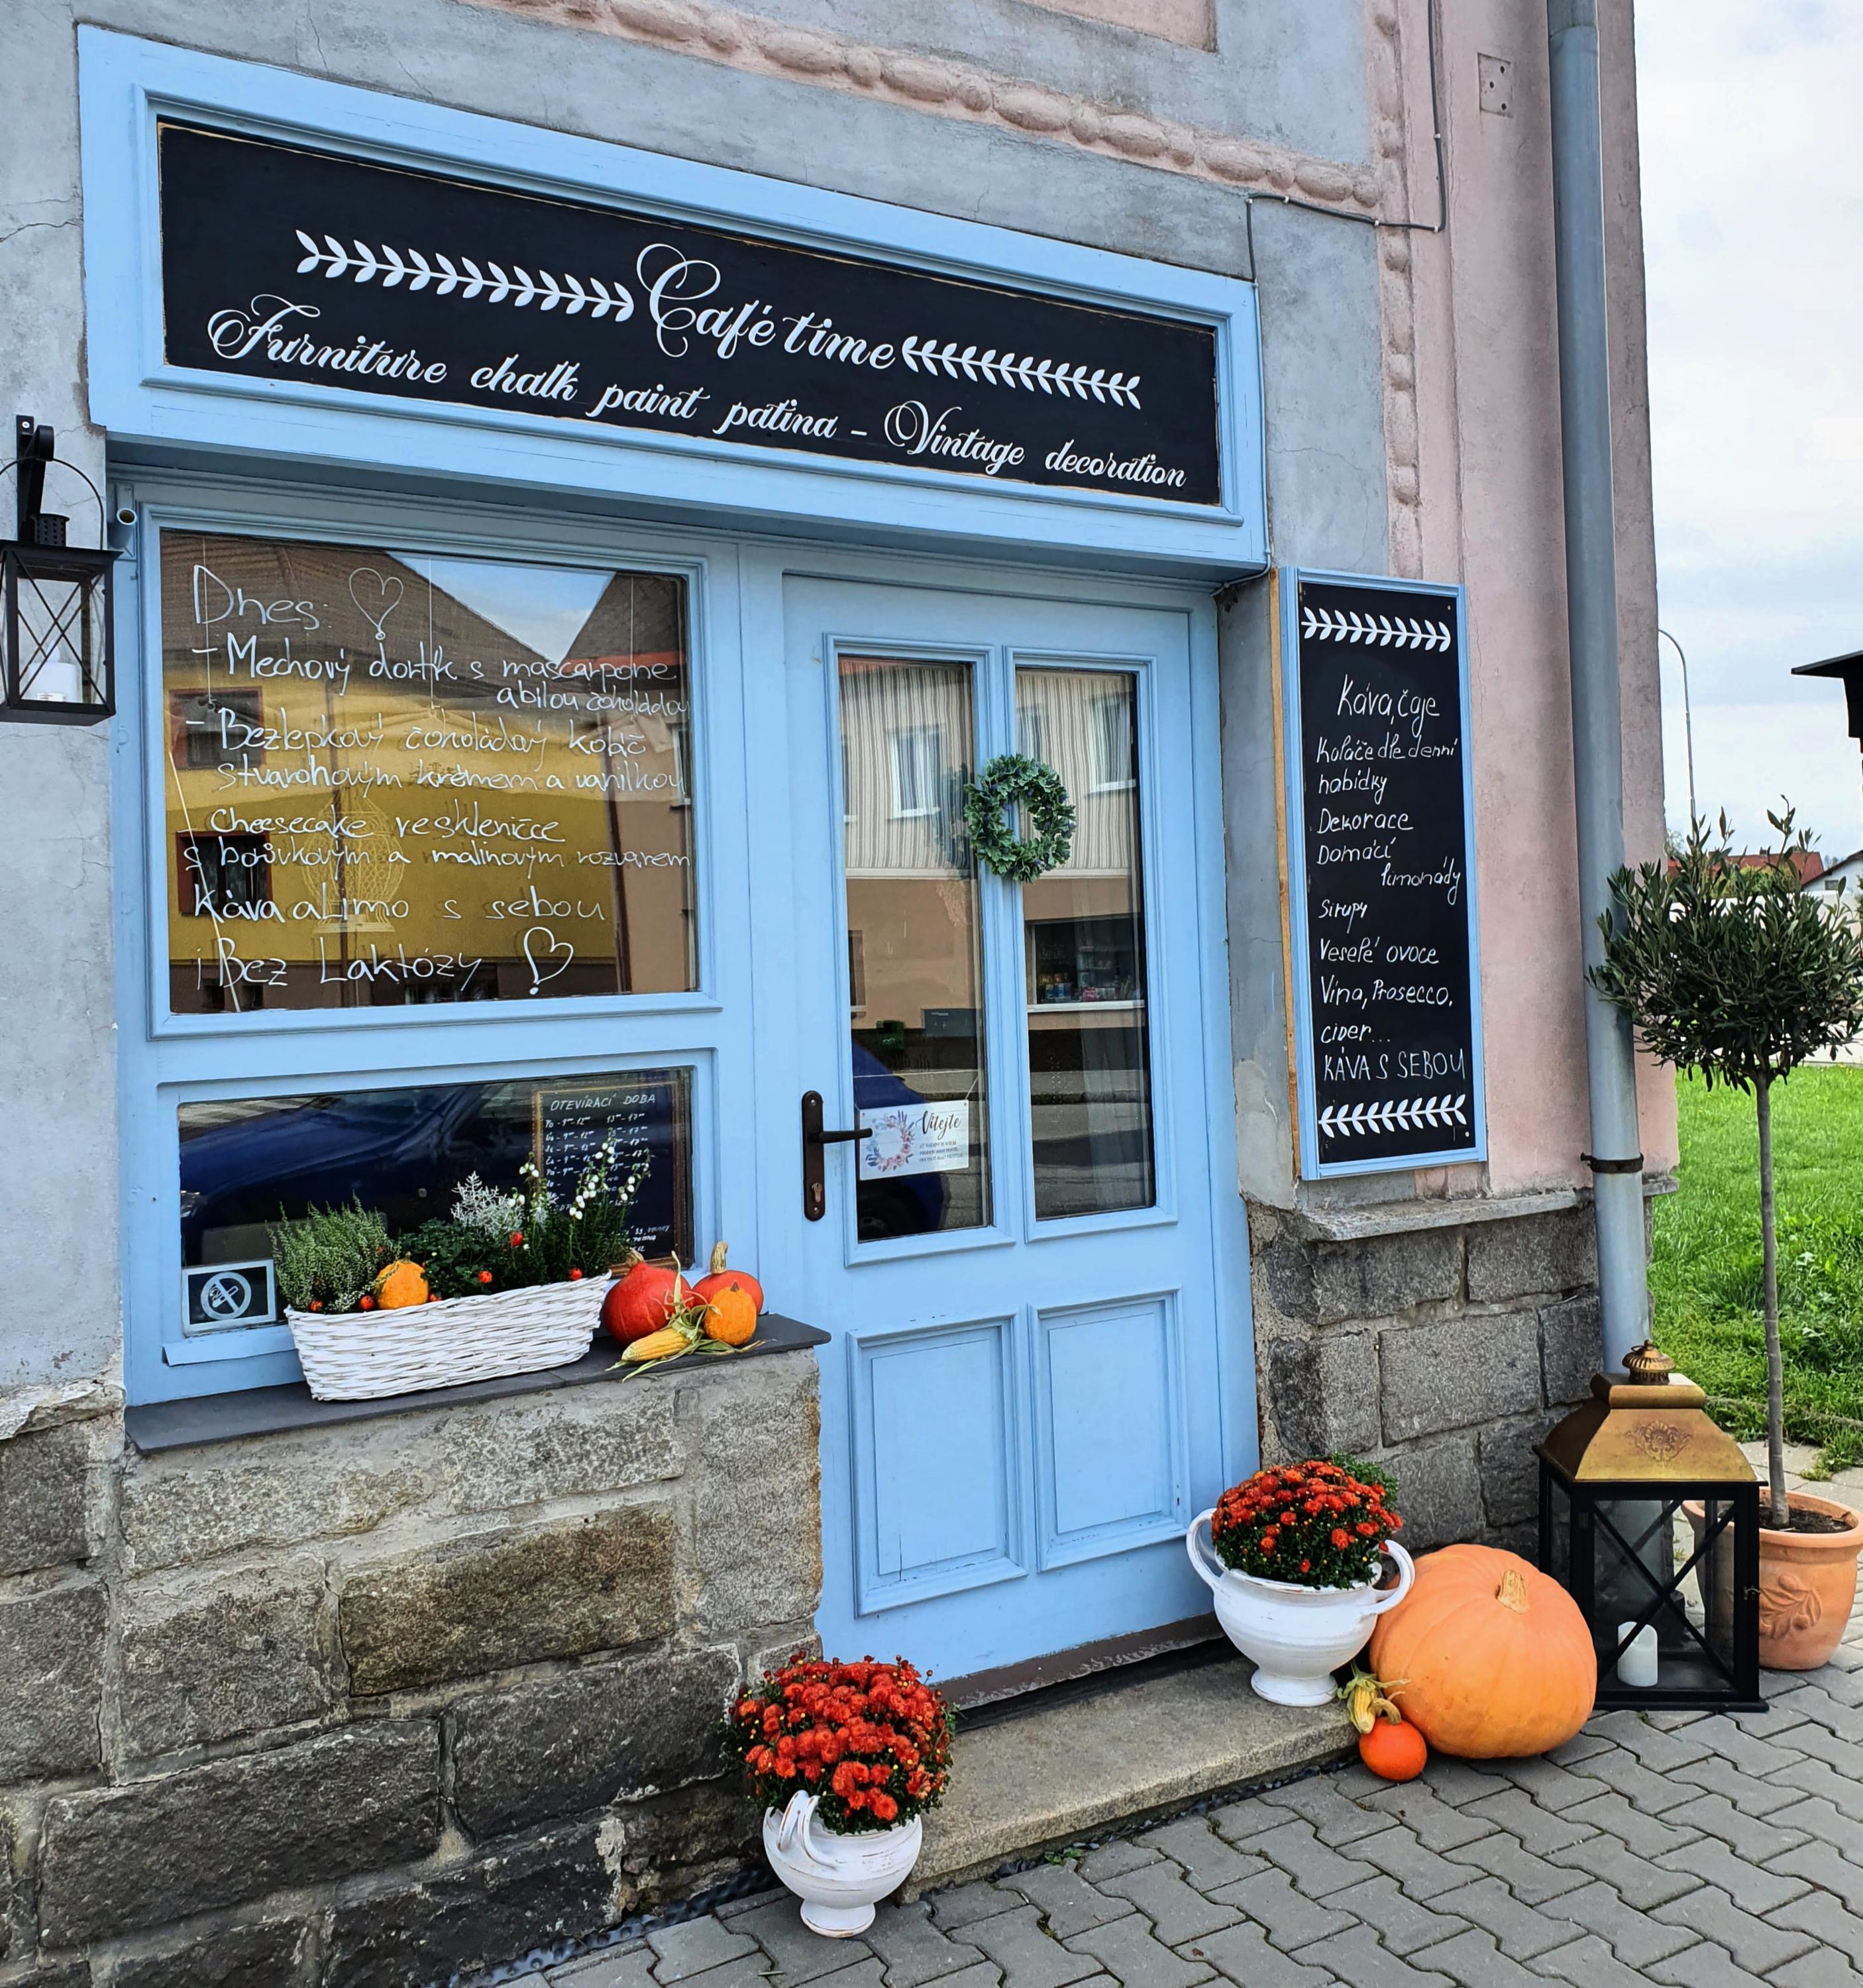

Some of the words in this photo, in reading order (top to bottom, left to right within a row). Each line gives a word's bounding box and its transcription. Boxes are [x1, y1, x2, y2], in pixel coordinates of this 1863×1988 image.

[636, 243, 775, 359] Café
[782, 312, 895, 370] time
[207, 294, 447, 384] Furniture
[471, 354, 580, 402] chalk
[586, 384, 710, 417] paint
[712, 399, 839, 438] patina
[884, 400, 1025, 474] Vintage
[1044, 439, 1187, 488] decoration
[227, 632, 350, 696] Mechový
[470, 660, 485, 680] s
[503, 659, 677, 693] mascarpone
[218, 706, 384, 765] Bezlepkový
[1316, 735, 1373, 763] Koláče
[1377, 732, 1406, 759] dle
[1408, 735, 1458, 758] denní
[546, 774, 565, 789] a
[576, 760, 686, 795] vanilkou
[1319, 767, 1387, 804] nabídky
[211, 804, 374, 838] Cheesecake
[1317, 808, 1414, 834] Dekorace
[388, 851, 411, 863] a
[432, 840, 564, 879] malinovým
[1317, 837, 1397, 864] Domácí
[1380, 856, 1461, 906] limonády
[194, 883, 286, 923] Káva
[443, 899, 461, 919] s
[485, 885, 605, 920] sebou
[1318, 899, 1367, 934] Sirupy
[217, 936, 288, 988] Bez
[320, 936, 482, 991] Laktózy
[1320, 936, 1380, 963] Veselé
[1386, 945, 1439, 964] ovoce
[1320, 975, 1367, 1009] Vína,
[1324, 1046, 1371, 1081] KÁVA
[1376, 1054, 1388, 1079] S
[1397, 1048, 1465, 1080] SEBOU
[623, 1093, 656, 1105] DOBA
